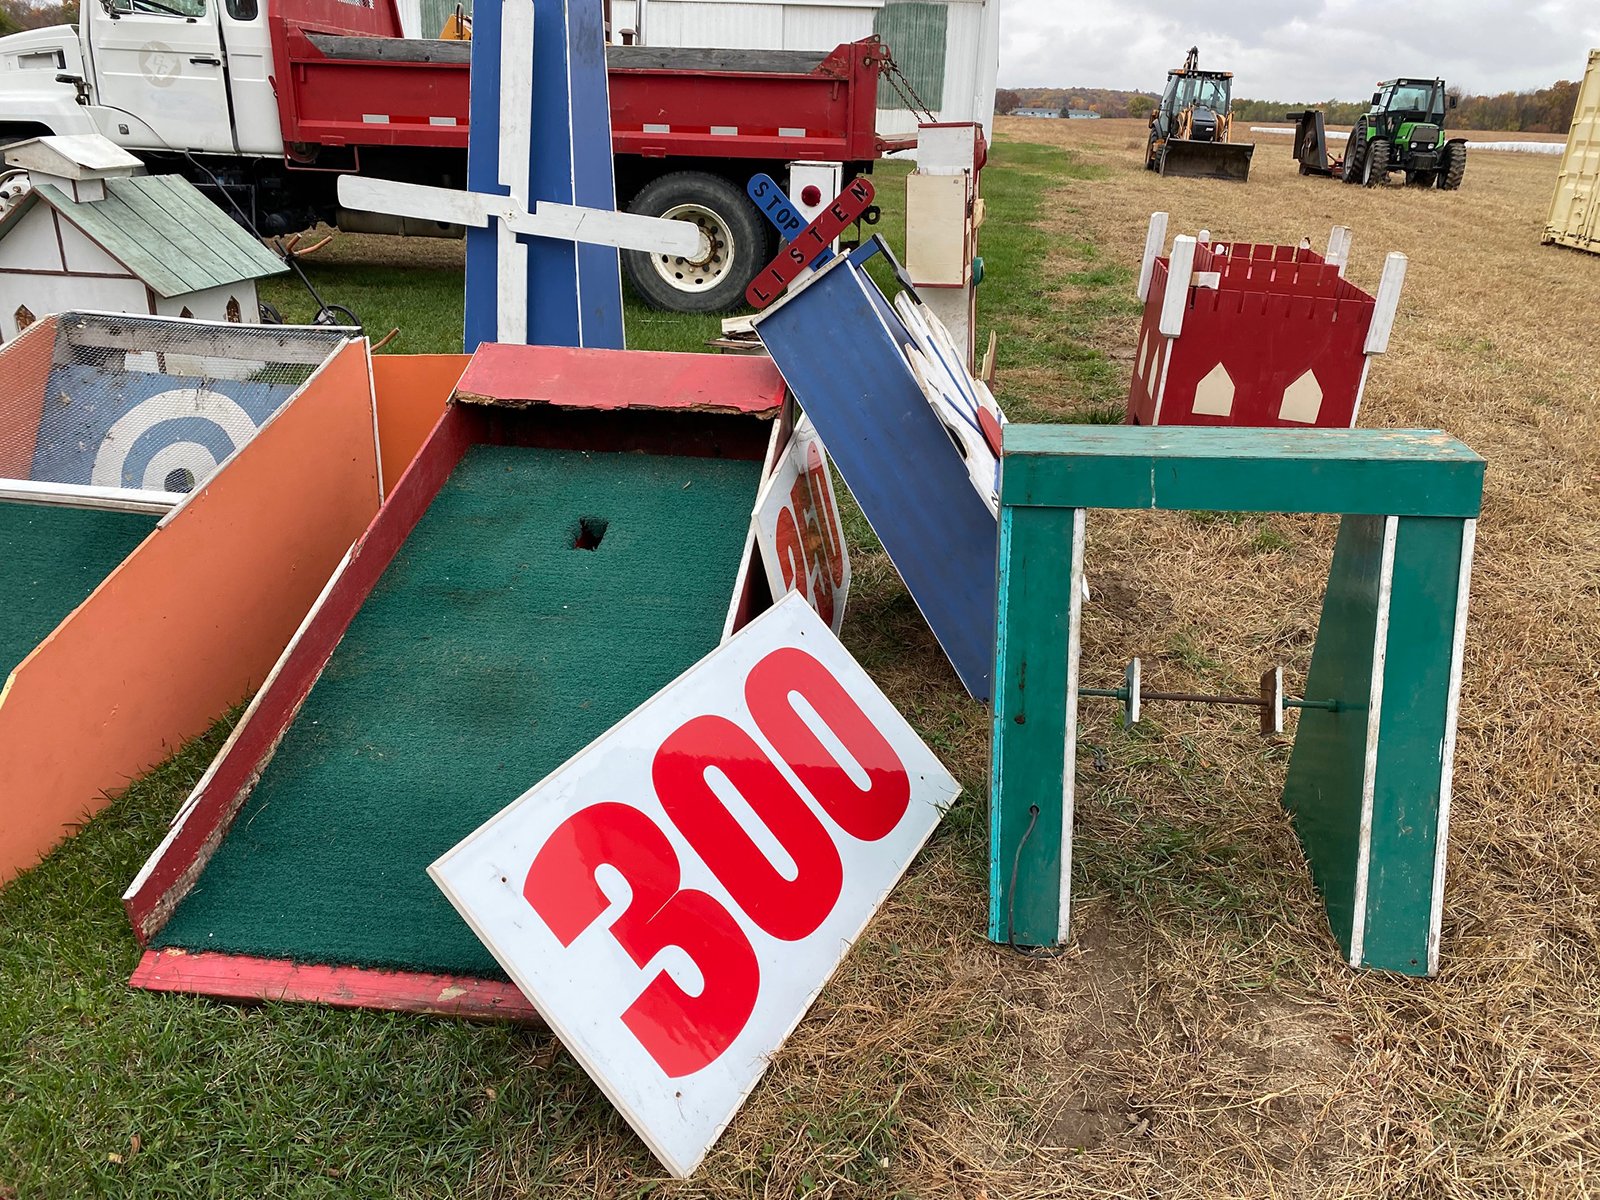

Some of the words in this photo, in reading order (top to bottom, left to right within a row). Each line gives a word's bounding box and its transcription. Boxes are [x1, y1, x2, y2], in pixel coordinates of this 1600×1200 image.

[753, 183, 868, 301] LISTEN
[754, 182, 800, 230] STOP
[523, 647, 911, 1079] 300
